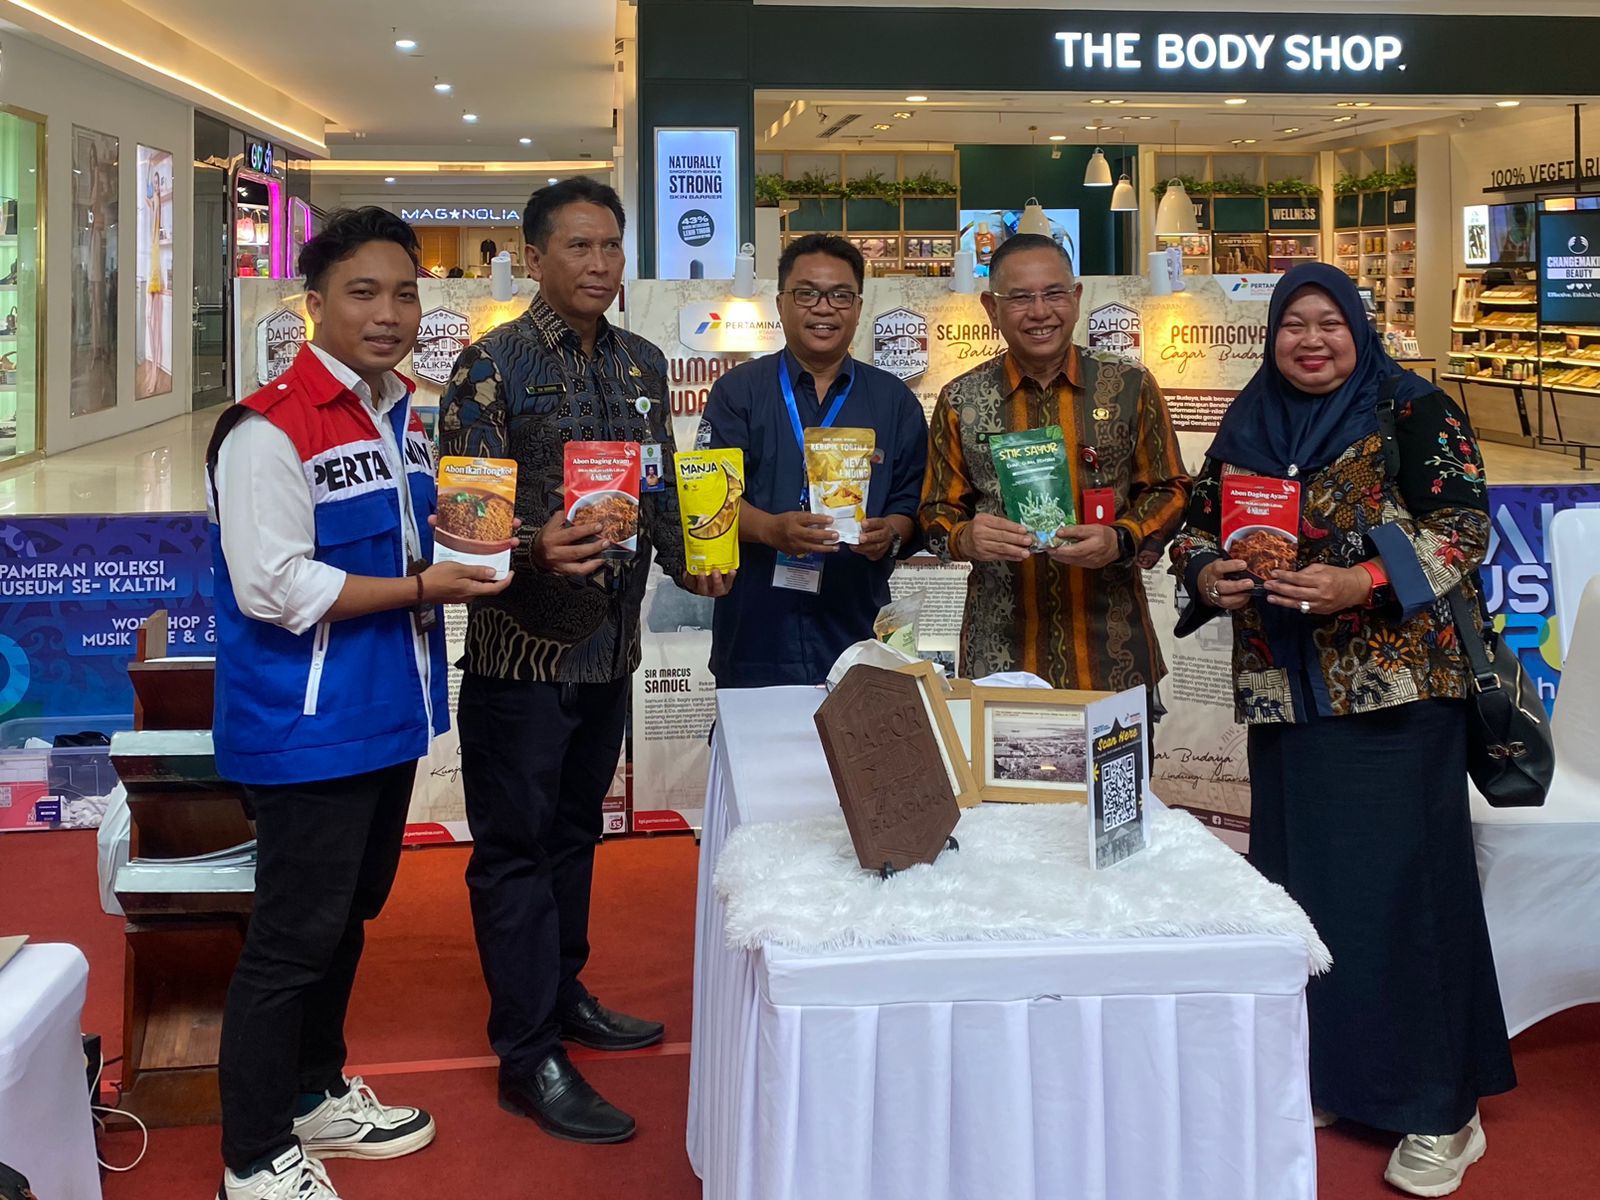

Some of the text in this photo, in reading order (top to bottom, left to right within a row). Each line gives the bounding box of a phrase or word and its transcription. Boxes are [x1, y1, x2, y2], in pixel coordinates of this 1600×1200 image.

[1055, 32, 1141, 68] THE
[1157, 33, 1275, 70] BODY
[669, 155, 722, 169] NATURALLY
[1490, 156, 1600, 188] 100% VEGETRI
[669, 174, 722, 194] STRONG
[681, 215, 709, 225] 43%
[1272, 208, 1316, 221] WELLNESS
[1547, 255, 1600, 268] CHANGEMAKI
[1565, 269, 1593, 278] BEAUTY
[416, 323, 470, 336] DAHOR
[725, 320, 782, 330] PERTAMINA
[874, 322, 928, 336] DAHOR
[1088, 318, 1140, 331] DAHOR
[267, 326, 307, 342] DAHOR
[413, 361, 455, 370] BALIKPA
[874, 359, 928, 368] BALIKPAPAN
[1160, 343, 1266, 374] Cagar Buda
[999, 442, 1059, 461] STIK SAYUR
[314, 450, 393, 493] PERTA
[680, 461, 718, 476] MANJA
[1247, 491, 1270, 500] Daging
[0, 560, 164, 579] PAMERAN KOLEKSI
[0, 580, 63, 596] USEUM
[109, 577, 176, 593] KALTIM
[112, 616, 201, 630] WORHOP
[82, 633, 131, 647] MUSIK
[183, 631, 196, 643] &
[645, 668, 691, 679] SIR MARCUS
[645, 679, 692, 693] SAMUEL
[1097, 737, 1118, 751] Scan
[1118, 727, 1138, 744] Here
[1172, 747, 1233, 776] Budaya
[430, 765, 462, 783] Kunj
[611, 820, 622, 829] 35
